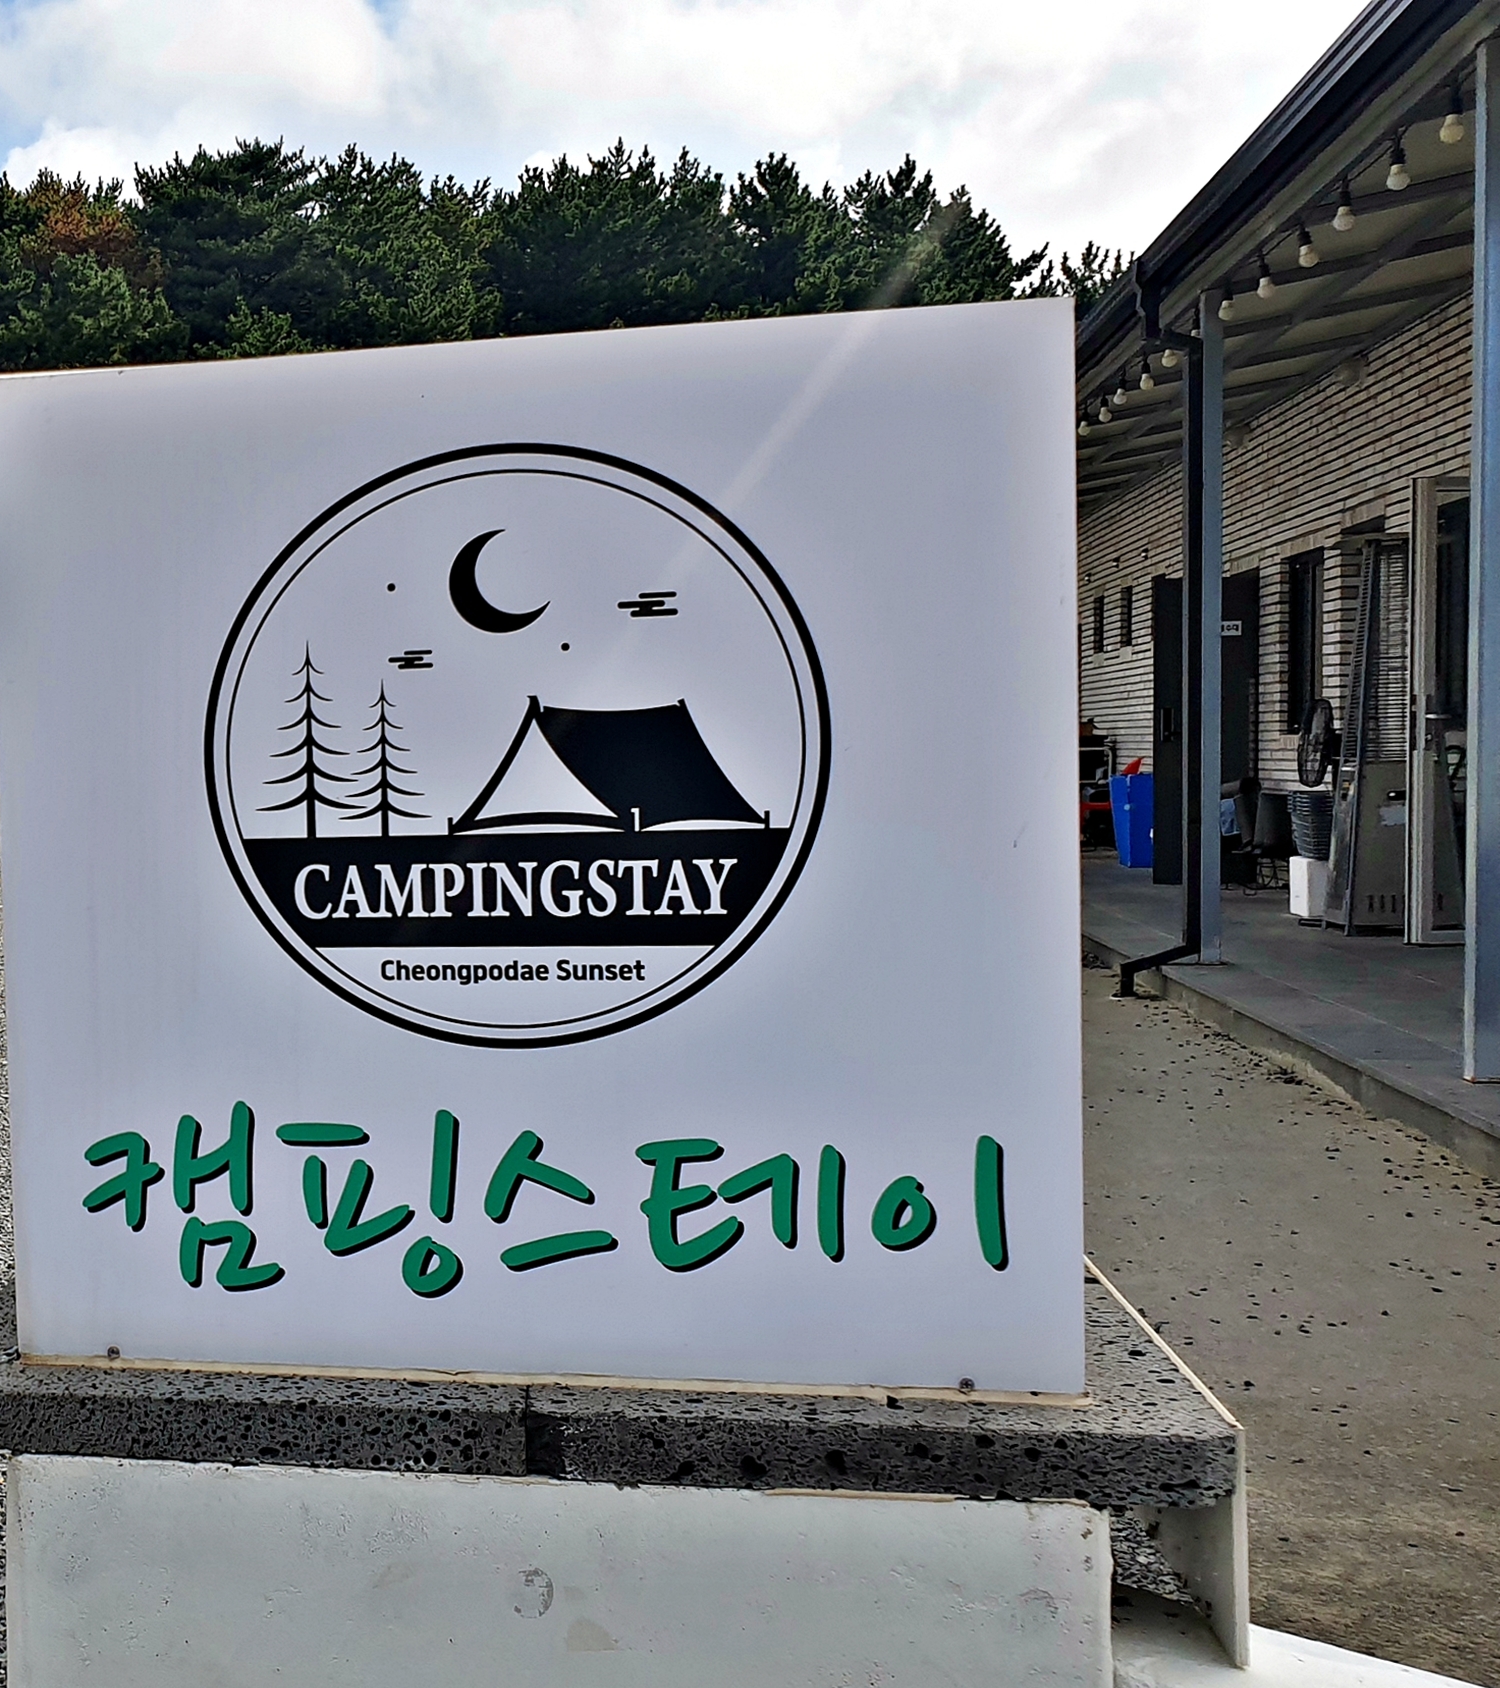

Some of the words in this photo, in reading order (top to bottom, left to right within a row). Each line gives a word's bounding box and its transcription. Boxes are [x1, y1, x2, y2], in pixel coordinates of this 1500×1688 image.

[293, 858, 738, 920] CAMPINGSTAY
[379, 959, 549, 986] Cheongpodae
[556, 959, 646, 982] Sunset
[82, 1101, 1009, 1298] 캠핑스테이
